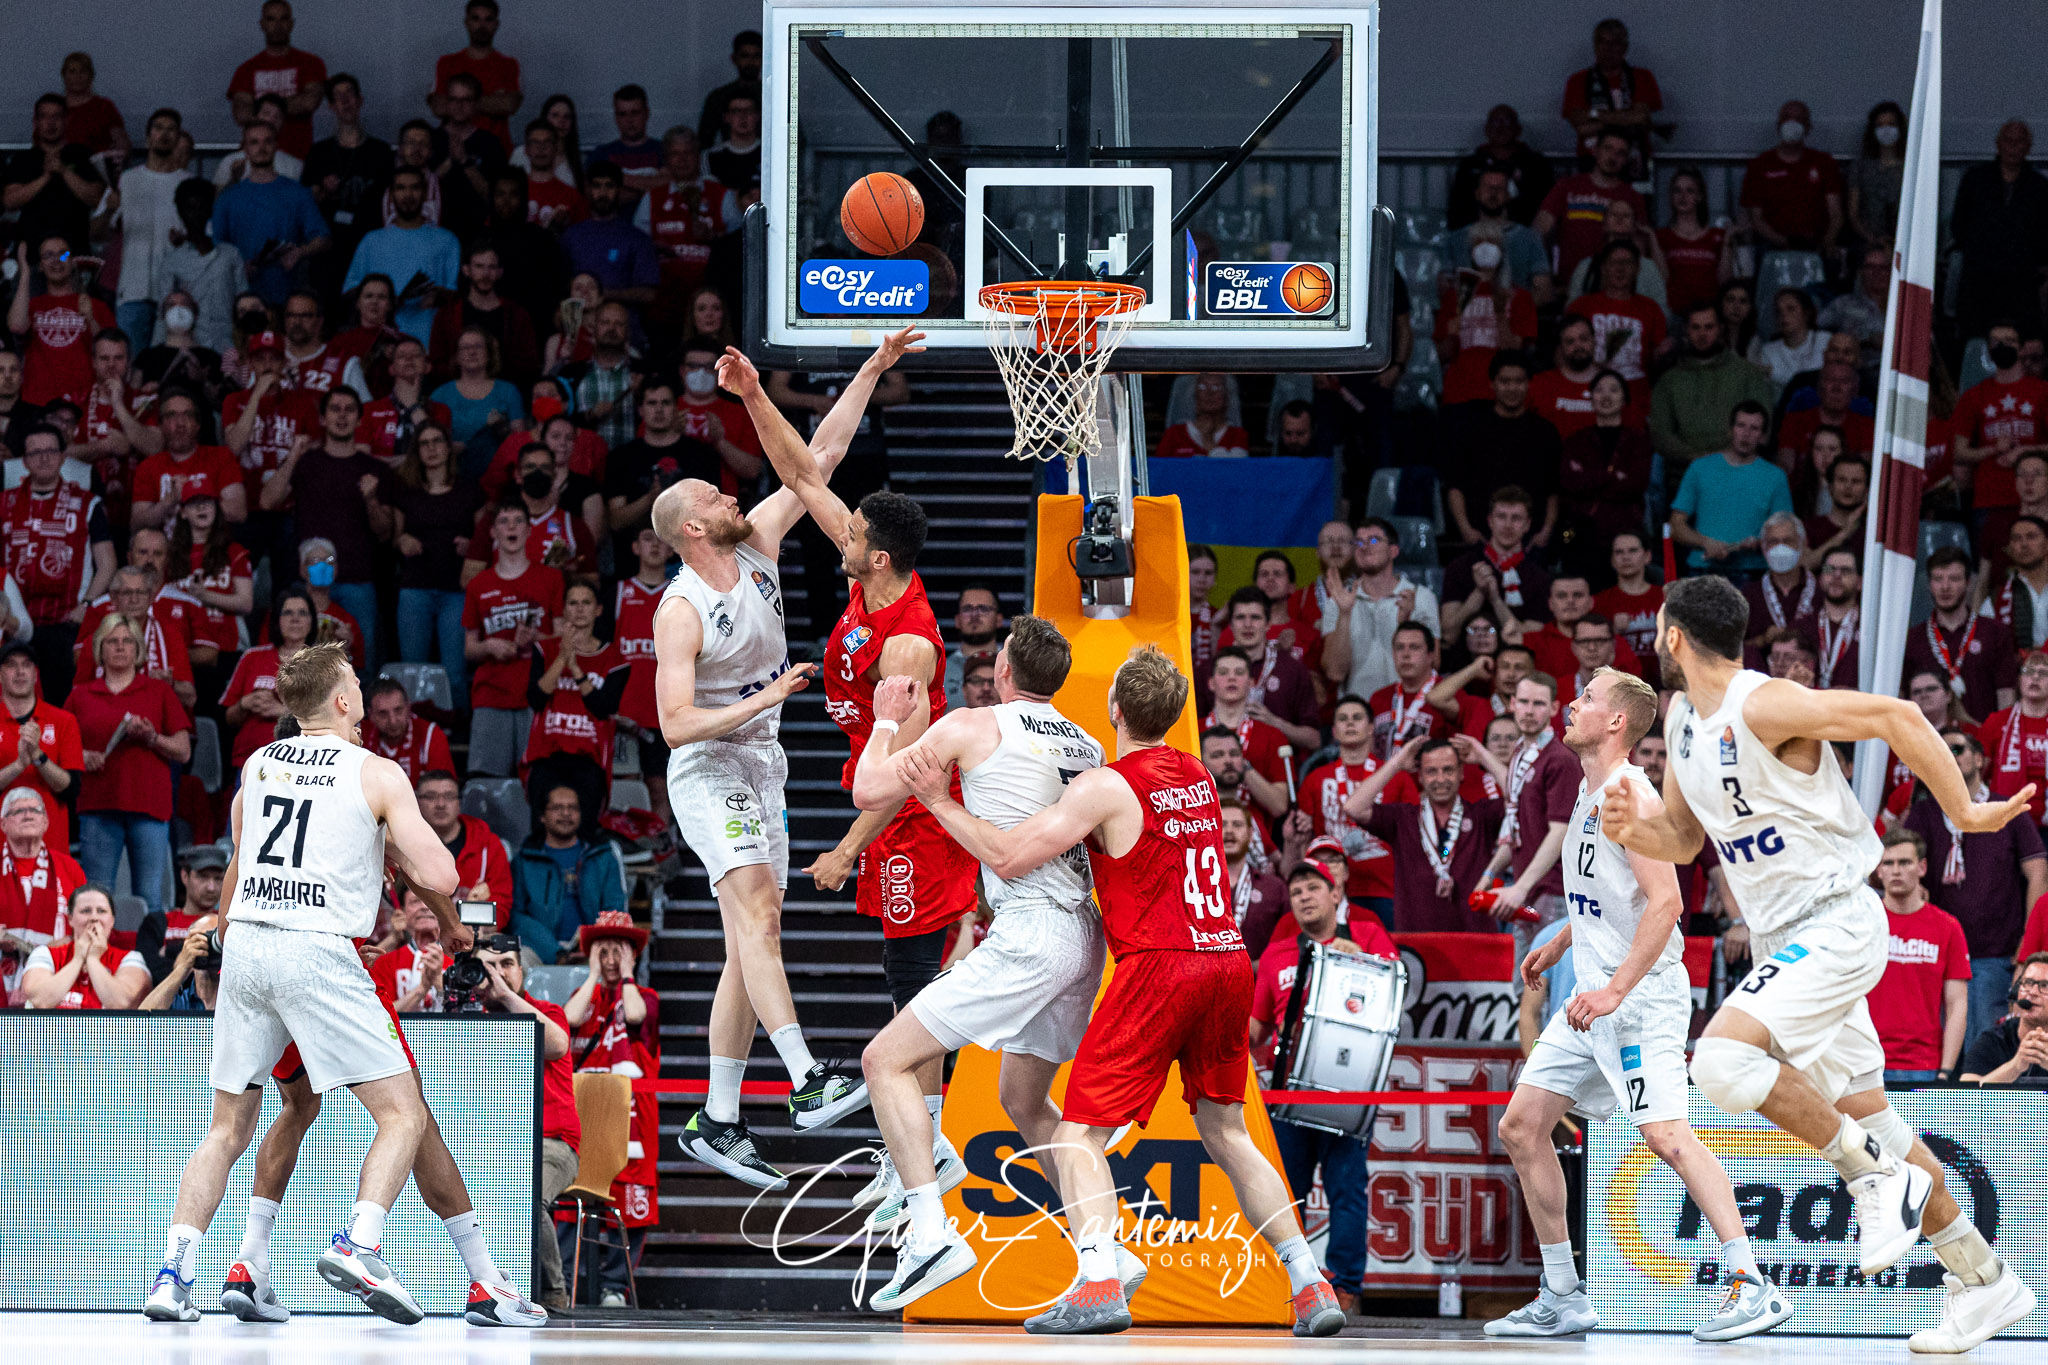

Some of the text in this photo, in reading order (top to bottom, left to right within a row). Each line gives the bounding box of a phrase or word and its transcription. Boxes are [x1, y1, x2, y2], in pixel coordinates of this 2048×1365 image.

[1215, 289, 1269, 310] BBL
[840, 653, 855, 682] 3
[263, 743, 341, 766] HOLLATZ
[295, 774, 337, 787] BLACK
[1722, 777, 1754, 818] 3
[257, 795, 313, 868] 21
[1578, 842, 1595, 878] 12
[242, 877, 326, 907] HAMBURG
[880, 861, 888, 918] AUTOMATION
[1184, 847, 1225, 920] 43
[1741, 964, 1780, 994] 3
[1626, 1077, 1649, 1113] 12
[961, 1131, 1217, 1223] SXT
